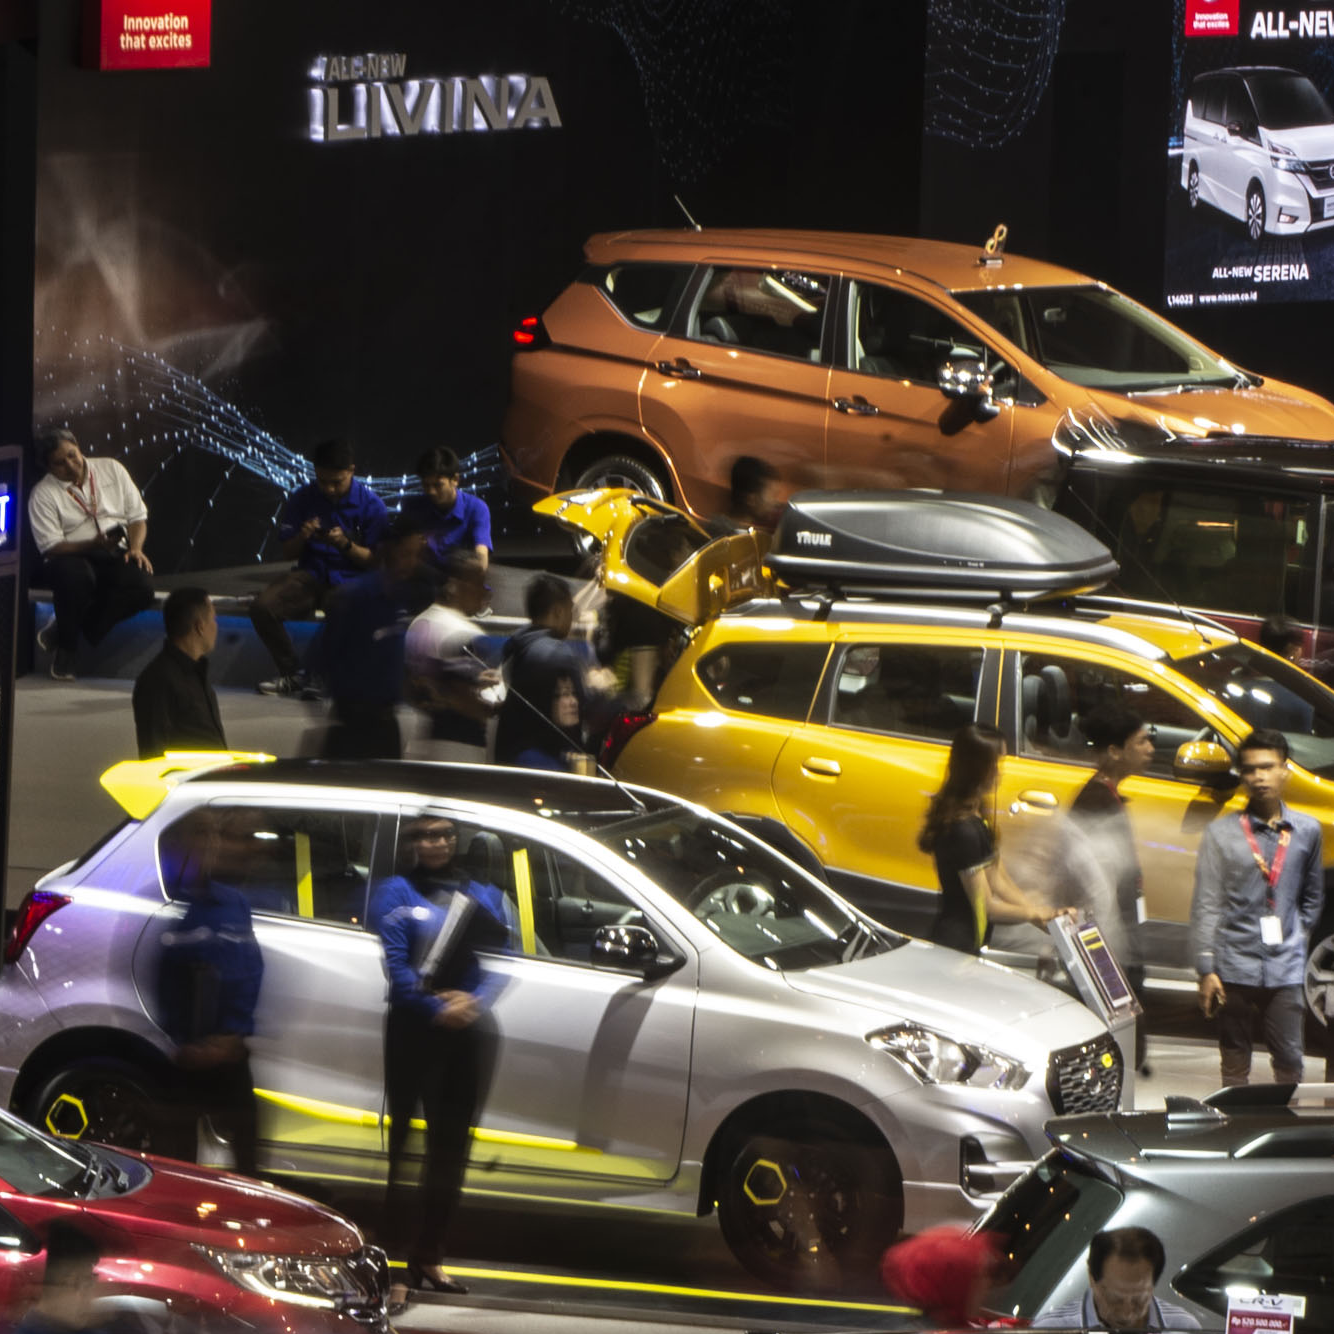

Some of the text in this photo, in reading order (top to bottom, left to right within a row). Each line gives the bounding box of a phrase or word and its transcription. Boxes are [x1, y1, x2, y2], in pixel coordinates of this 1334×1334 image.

[123, 12, 188, 30] Innovation
[120, 32, 192, 50] that excites
[325, 53, 407, 81] ALL-NEW
[323, 75, 563, 142] LIVINA
[1212, 263, 1309, 282] ALL-NEW SERENA
[796, 531, 832, 547] THULE
